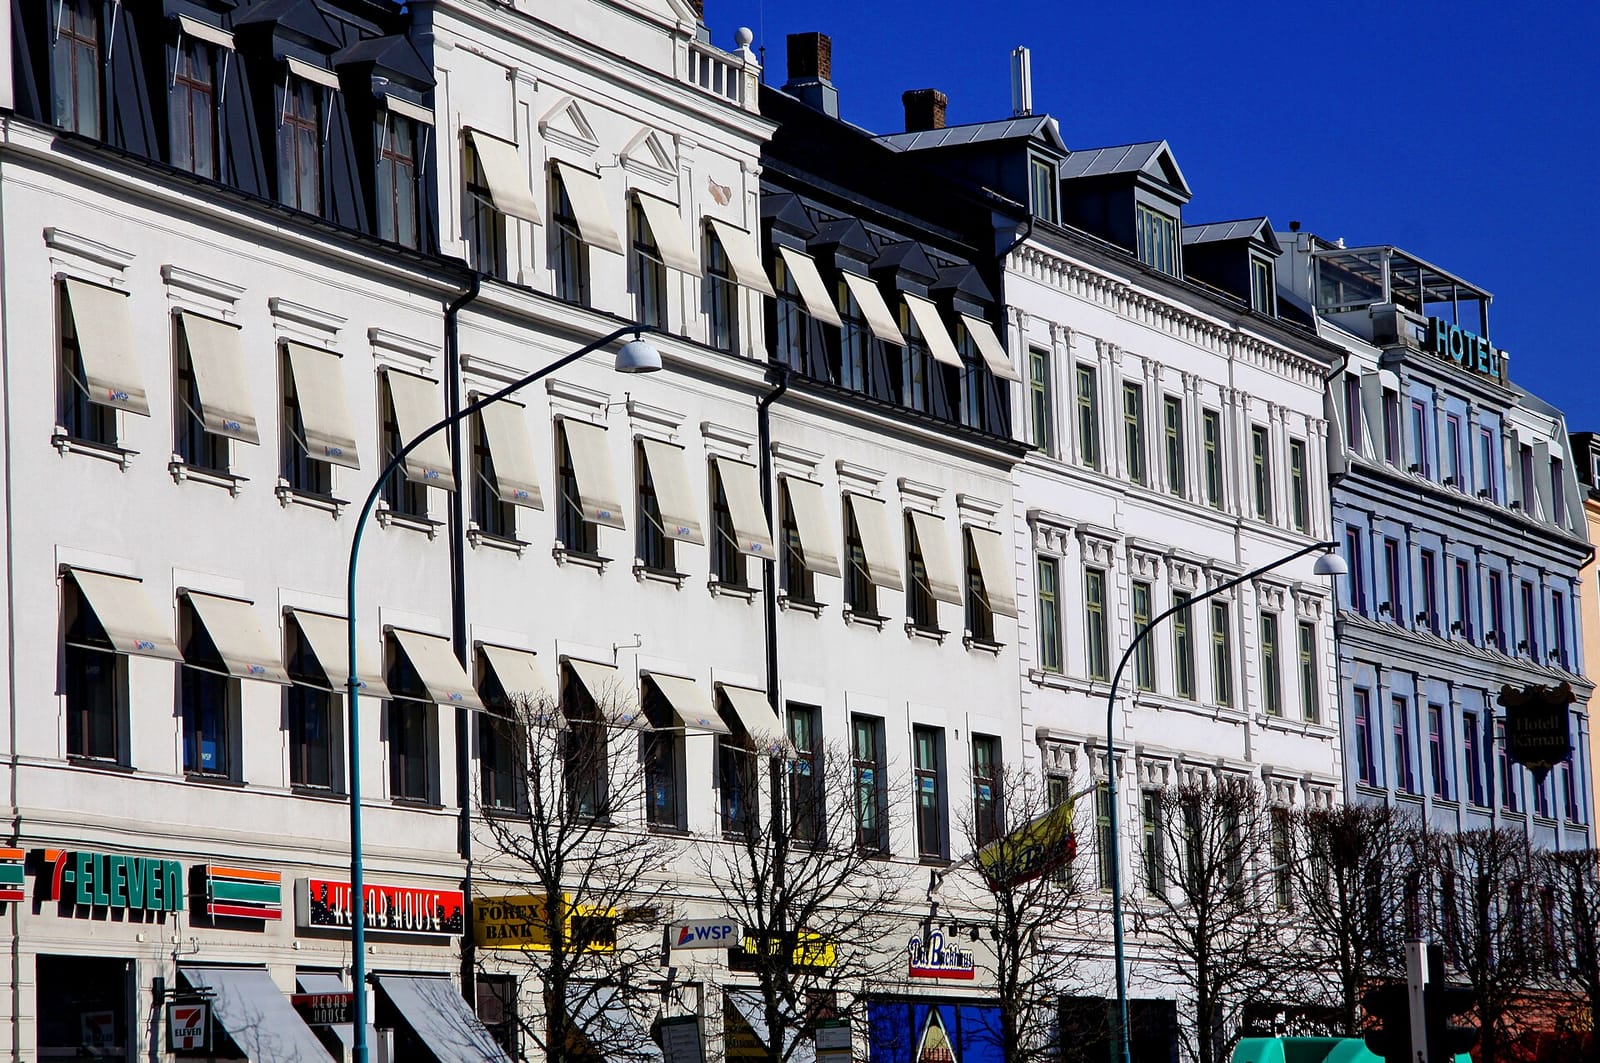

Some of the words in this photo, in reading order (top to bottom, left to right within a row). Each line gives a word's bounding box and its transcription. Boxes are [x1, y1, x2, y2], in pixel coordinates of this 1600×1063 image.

[1436, 316, 1499, 378] HOTEL
[114, 391, 129, 401] WSP
[1515, 714, 1560, 731] Hotell
[333, 885, 388, 928] KEAB
[393, 891, 441, 931] HOUSE
[478, 903, 541, 921] FOREX
[485, 923, 533, 940] BANK
[695, 925, 733, 941] WSP
[311, 995, 348, 1008] KEBAB
[313, 1008, 347, 1023] HOUSE
[175, 1008, 201, 1050] 7
